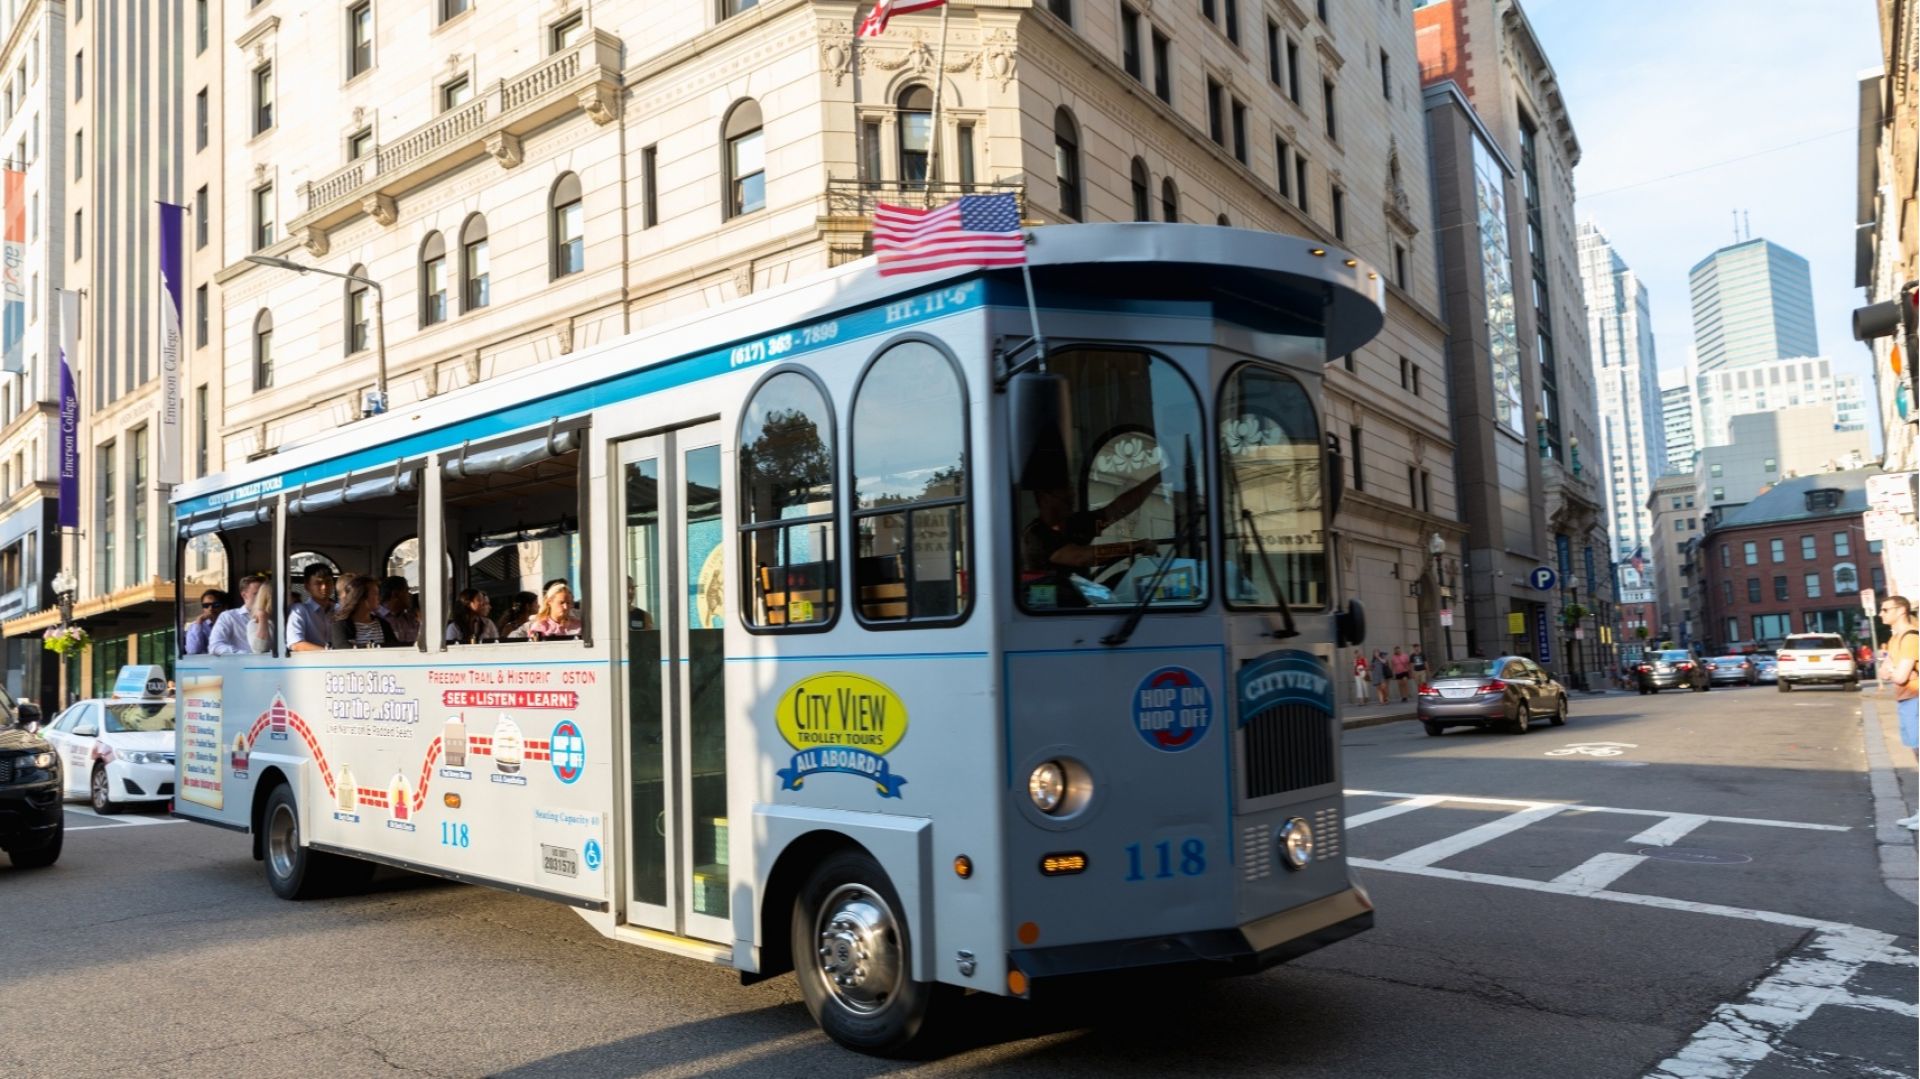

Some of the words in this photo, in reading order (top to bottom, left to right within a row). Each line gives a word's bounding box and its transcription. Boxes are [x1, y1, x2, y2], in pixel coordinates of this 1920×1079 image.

[886, 302, 919, 323] HT.
[164, 328, 180, 372] College
[730, 342, 766, 367] (617)
[803, 321, 838, 346] 7899
[164, 375, 177, 425] Emerson
[62, 396, 76, 432] College
[62, 434, 75, 478] Emerson
[1537, 570, 1551, 588] P
[147, 681, 166, 691] TAXI
[325, 671, 345, 694] See
[346, 671, 365, 694] the
[428, 670, 466, 684] FREEDOM
[469, 670, 494, 684] TRAIL
[498, 670, 504, 684] &
[562, 670, 596, 685] OSTON
[1245, 669, 1329, 700] CITYVIEW
[325, 696, 350, 719] ear
[351, 697, 370, 720] the
[447, 692, 467, 704] SEE
[476, 692, 516, 706] LISTEN
[526, 693, 574, 707] LEARN!
[794, 687, 832, 730] CITY
[837, 687, 886, 731] VIEW
[1140, 688, 1176, 708] HOP
[1181, 686, 1205, 706] ON
[1139, 710, 1175, 730] HOP
[1179, 707, 1208, 728] OFF
[797, 732, 842, 744] TROLLEY
[846, 733, 884, 746] TOURS
[796, 751, 818, 773] ALL
[821, 750, 883, 778] ABOARD!
[534, 808, 558, 823] Seating
[559, 812, 589, 828] Capacity
[441, 821, 470, 848] 118
[1124, 837, 1207, 882] 118
